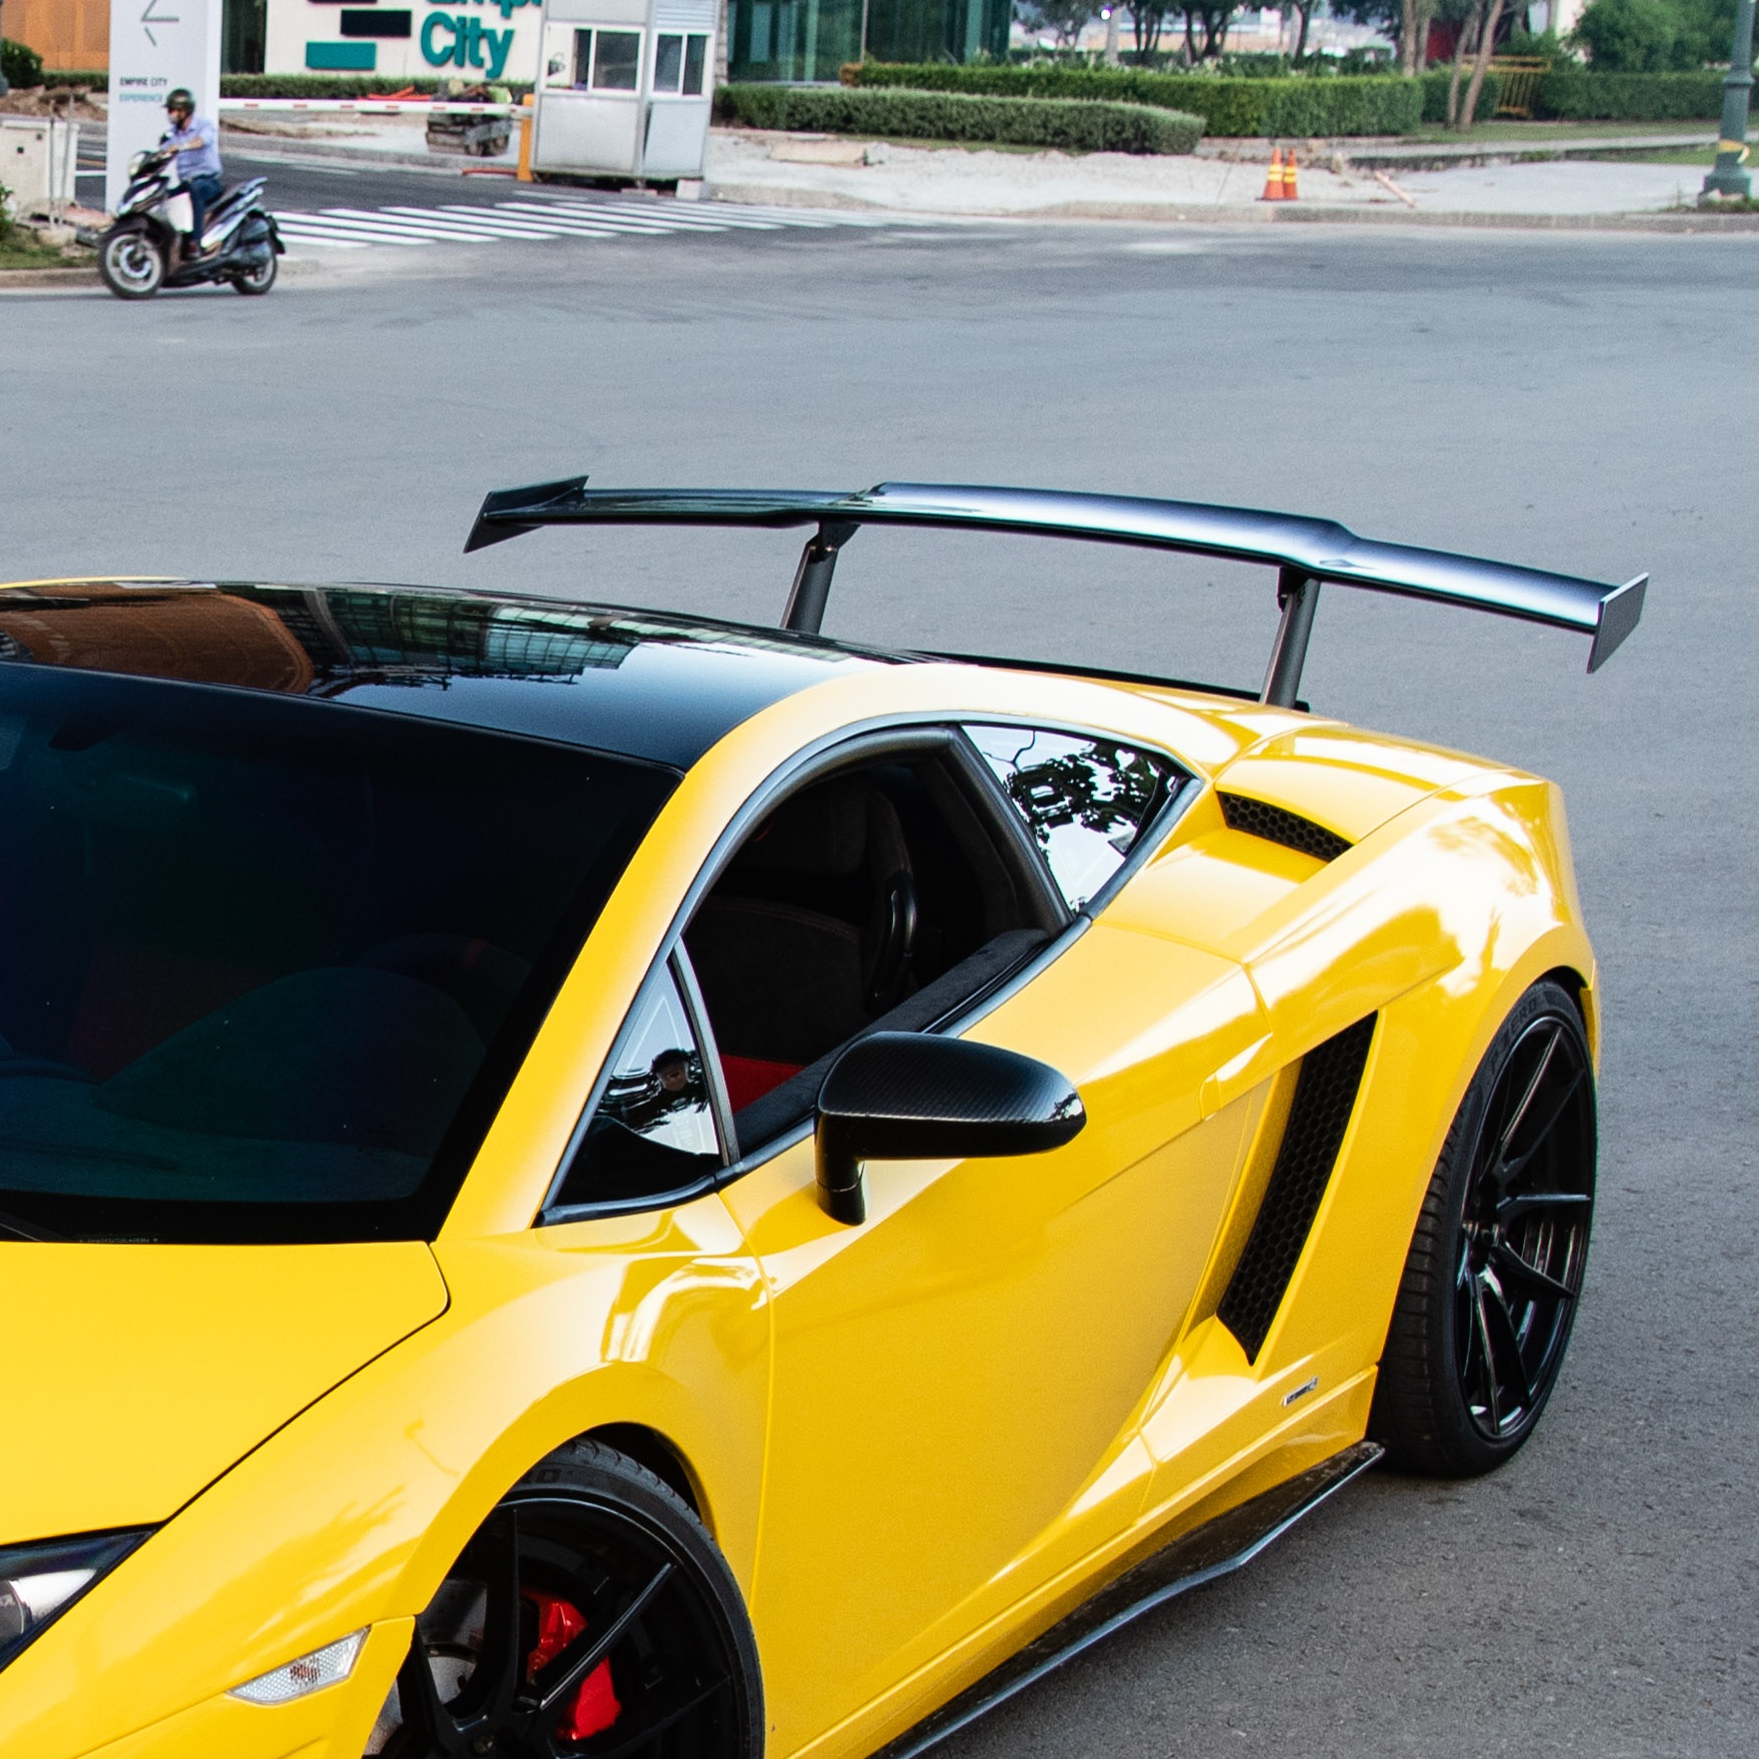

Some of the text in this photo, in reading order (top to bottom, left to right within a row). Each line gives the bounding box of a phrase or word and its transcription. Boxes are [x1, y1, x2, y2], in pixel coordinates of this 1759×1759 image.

[420, 10, 515, 79] City
[119, 76, 168, 87] EMPIRE CITY
